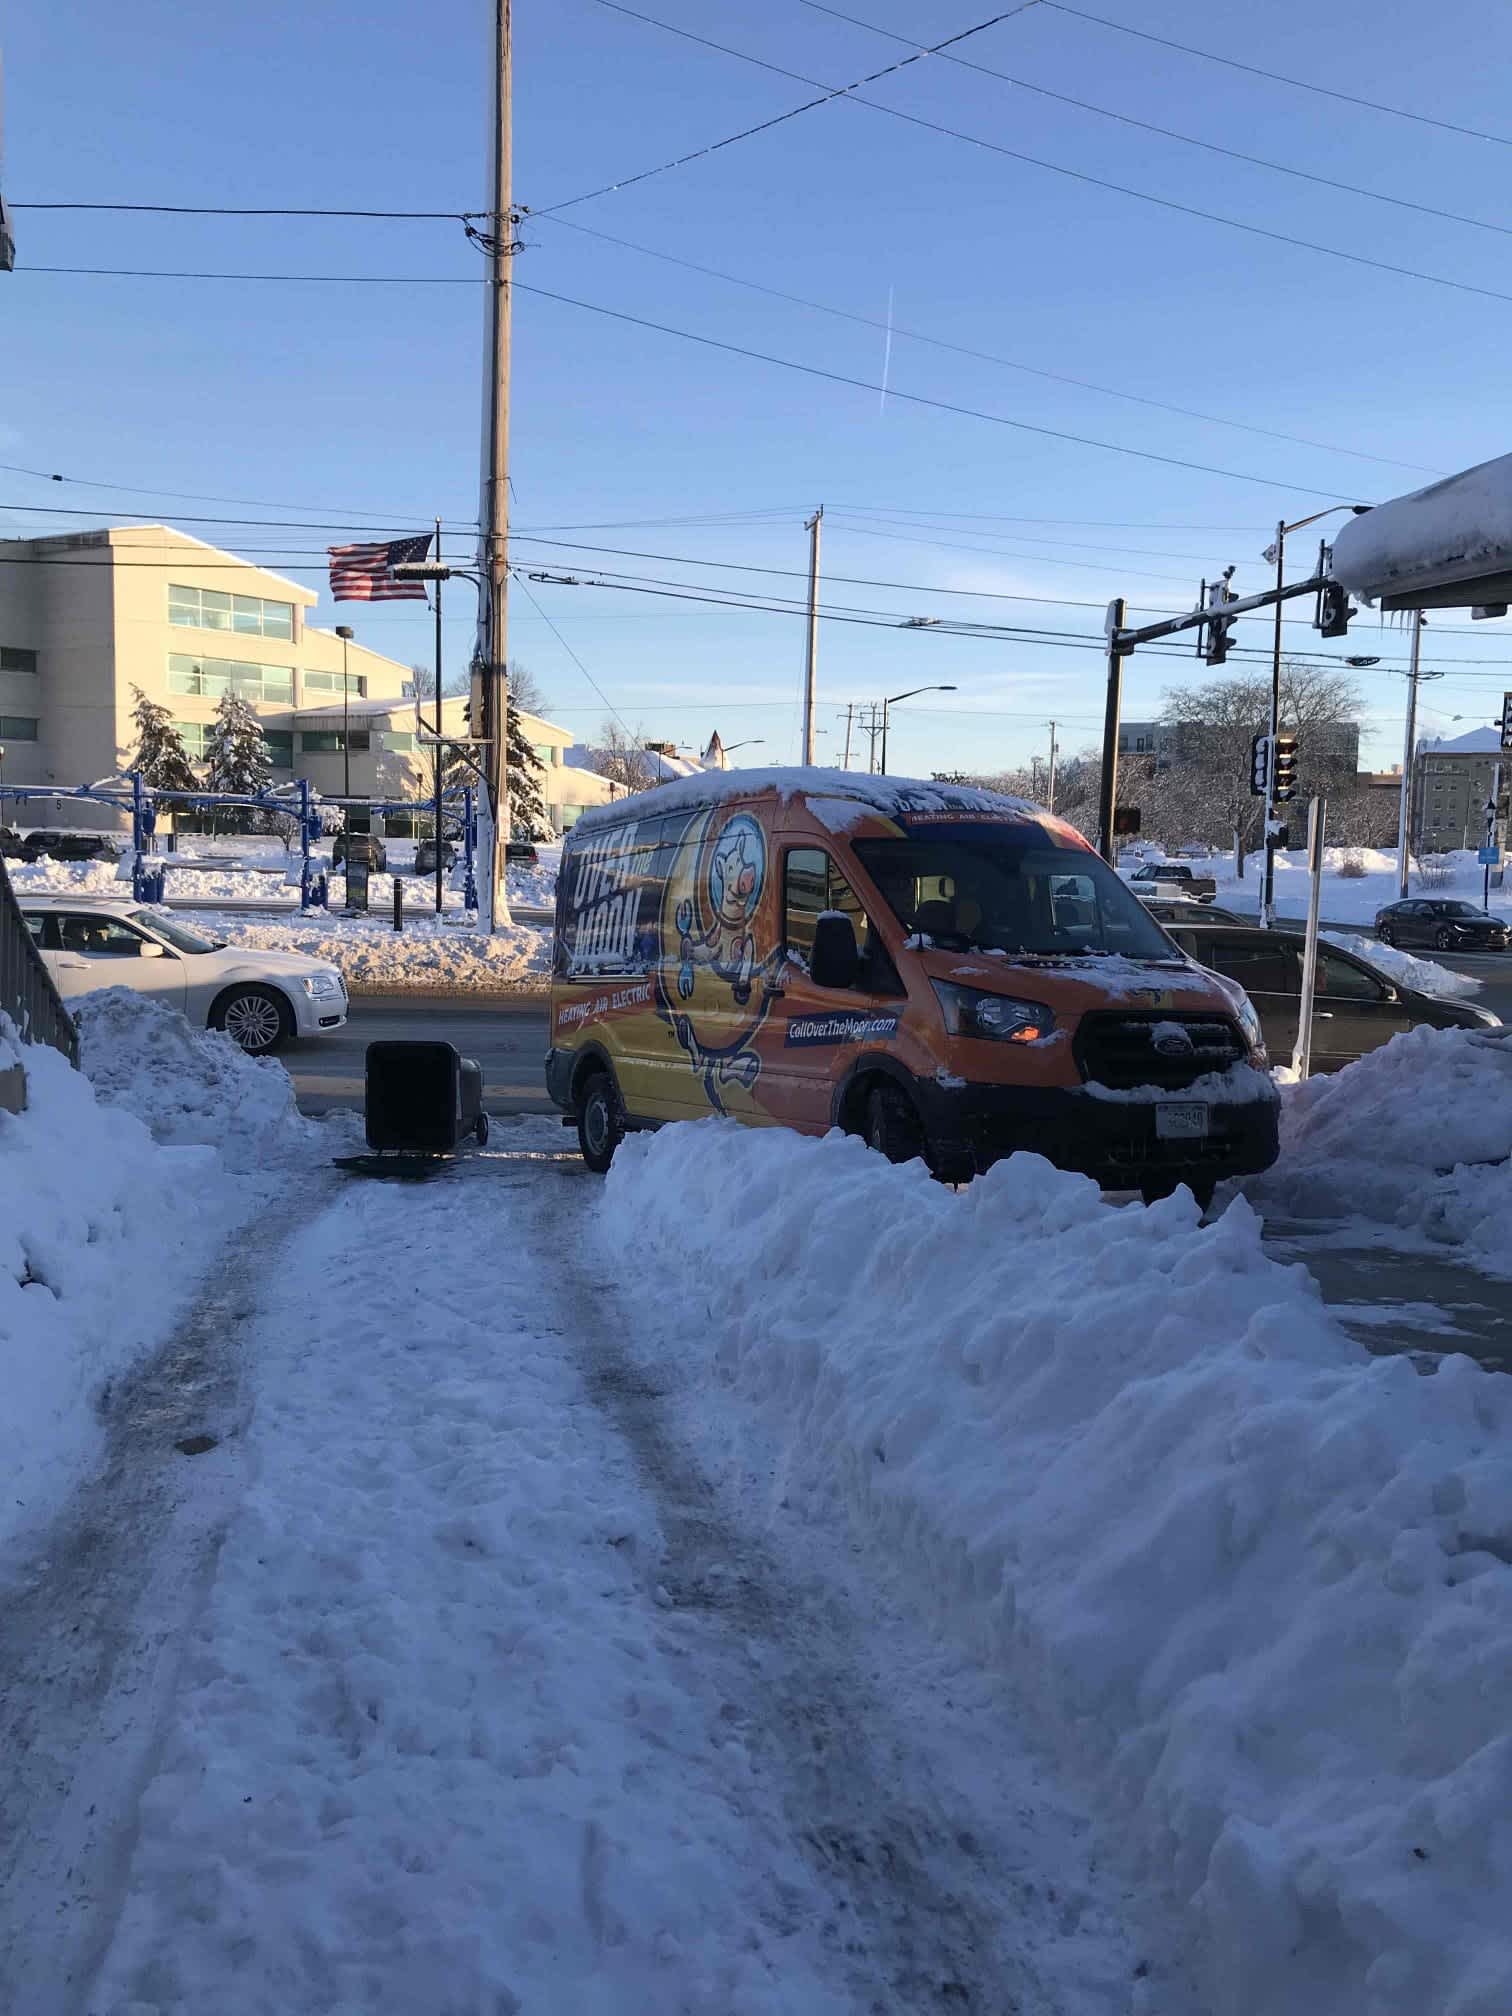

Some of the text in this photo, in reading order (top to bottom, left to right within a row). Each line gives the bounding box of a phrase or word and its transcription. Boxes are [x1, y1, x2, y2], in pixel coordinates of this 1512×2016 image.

[573, 823, 640, 910] OVER
[571, 887, 643, 968] MOON
[558, 983, 651, 1025] HEATING AIR ELECTRIC
